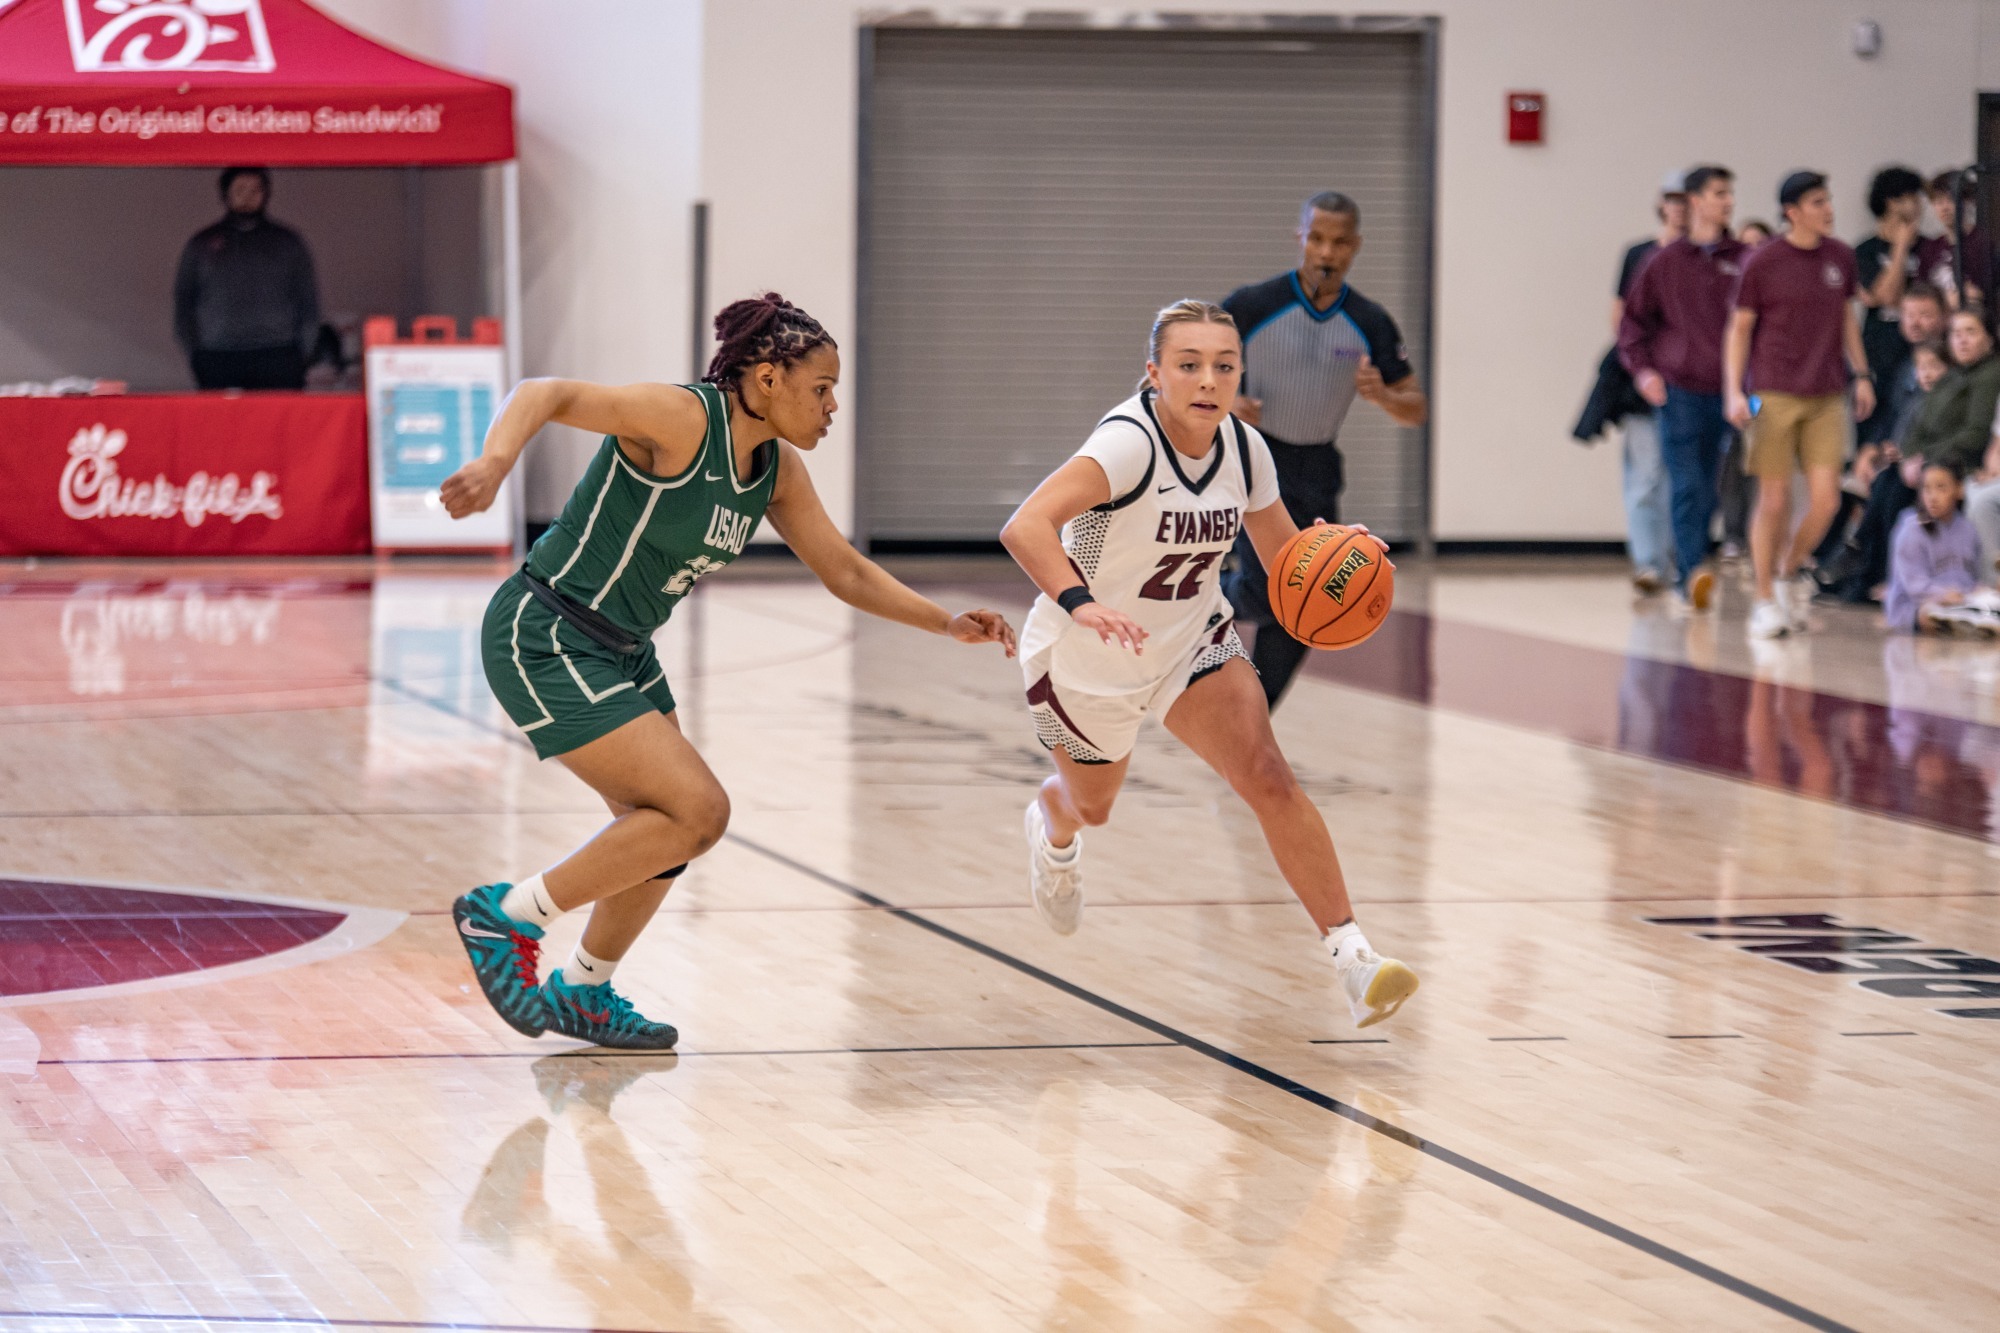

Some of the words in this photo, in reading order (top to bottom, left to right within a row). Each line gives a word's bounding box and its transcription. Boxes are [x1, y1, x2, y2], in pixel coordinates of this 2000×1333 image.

[11, 106, 42, 133] of
[44, 106, 97, 133] The
[99, 105, 204, 139] Original
[207, 105, 311, 133] Chicken
[313, 104, 441, 133] Sandwich
[703, 504, 752, 555] USAO
[1138, 550, 1223, 601] 22
[1322, 547, 1373, 605] NAIA
